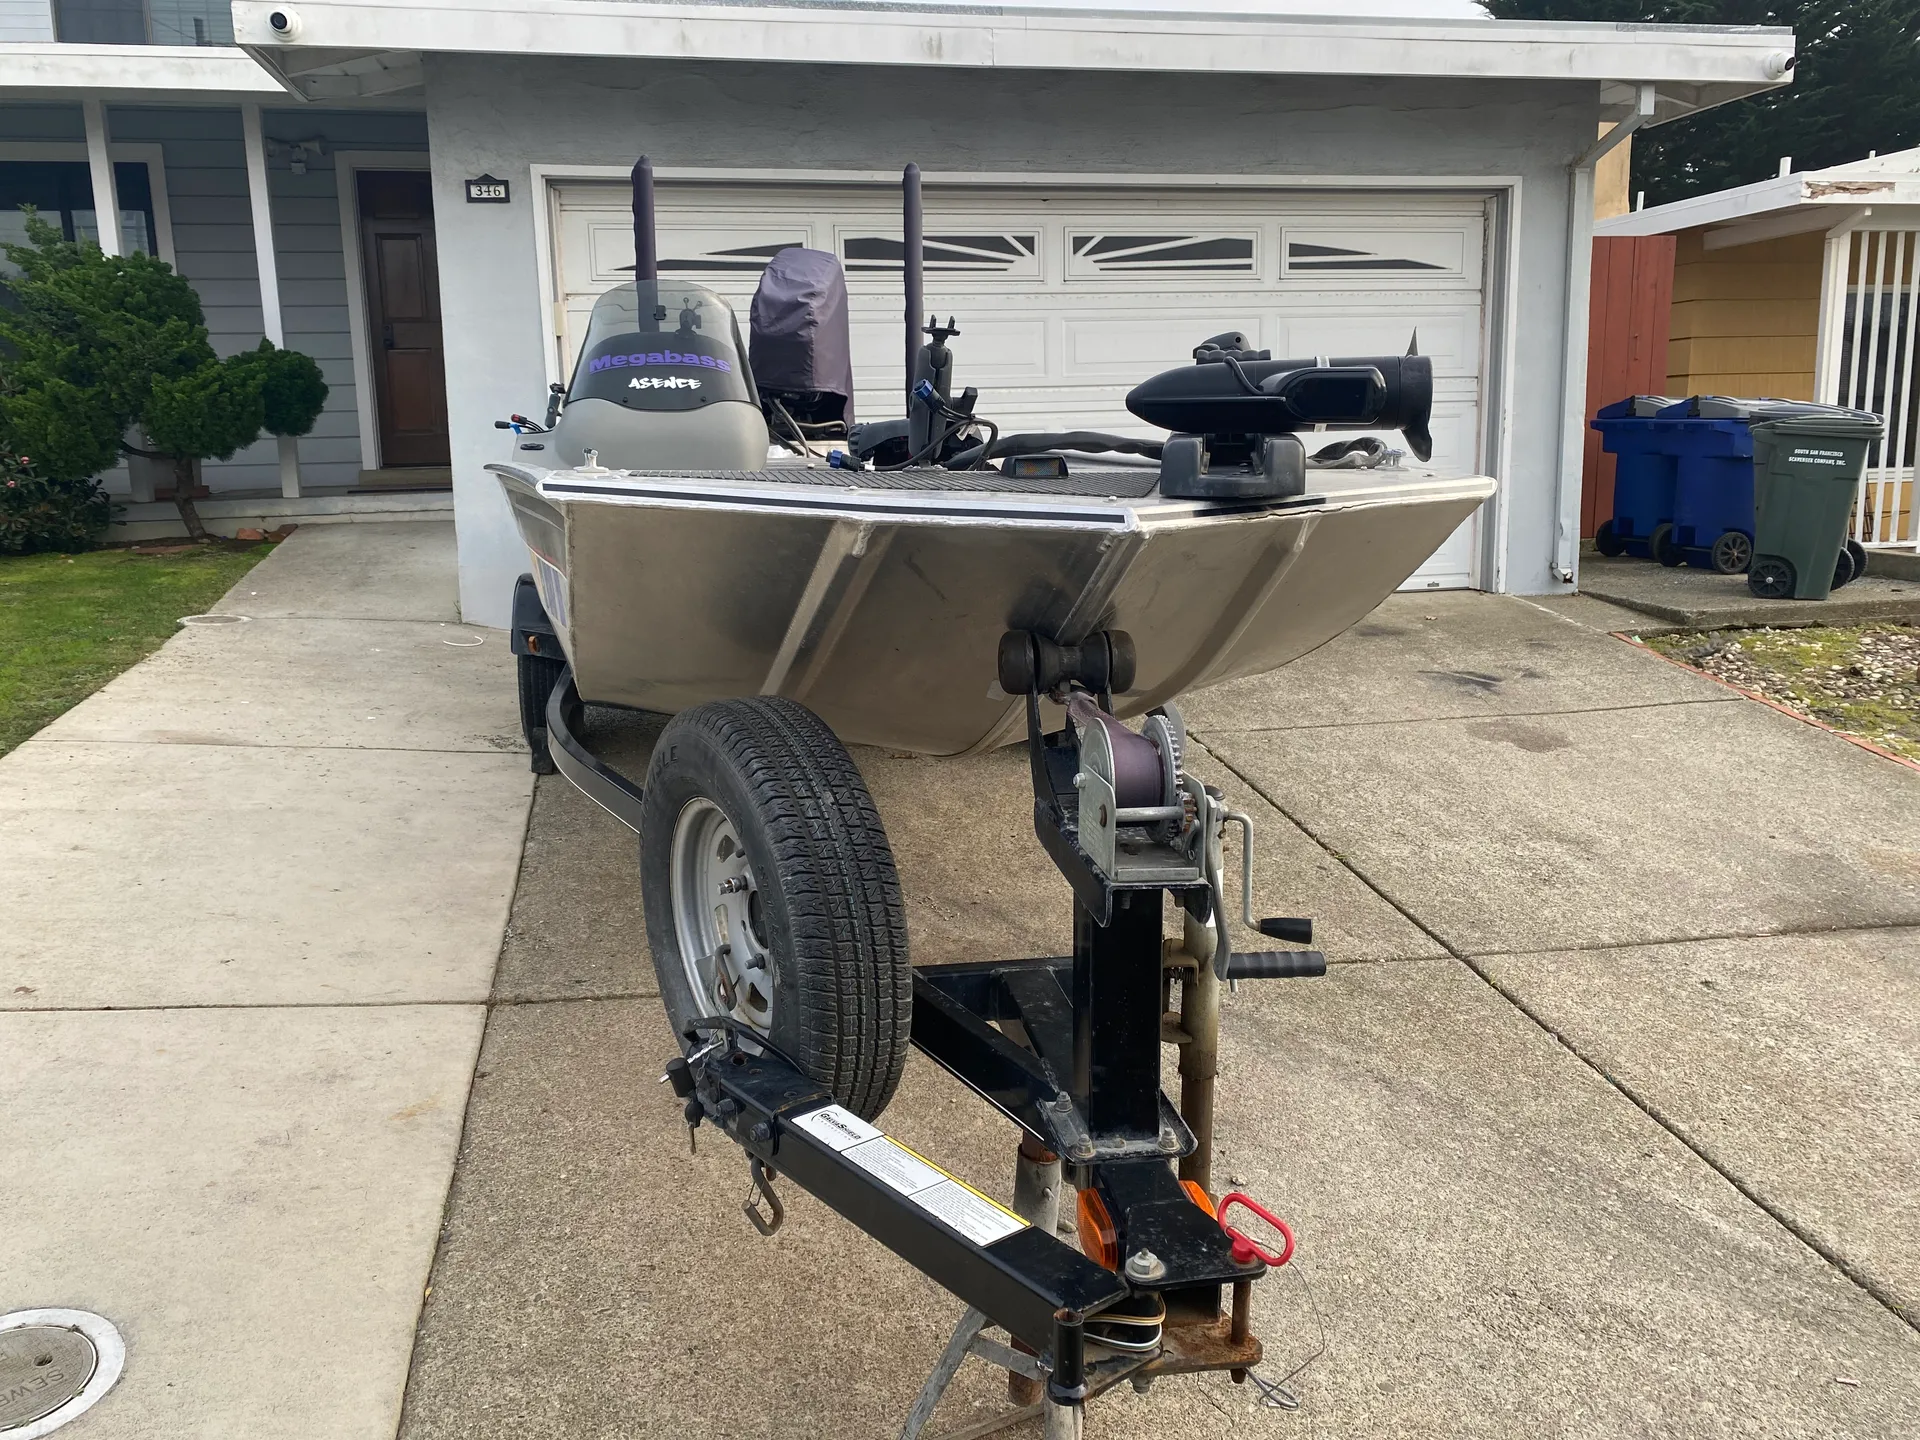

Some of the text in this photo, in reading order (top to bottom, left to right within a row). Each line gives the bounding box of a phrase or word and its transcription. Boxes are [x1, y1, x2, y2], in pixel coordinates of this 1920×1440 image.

[475, 185, 501, 197] 346
[589, 350, 732, 373] Megabass
[628, 376, 702, 390] ASENCE
[1819, 450, 1844, 458] FRANCISCO
